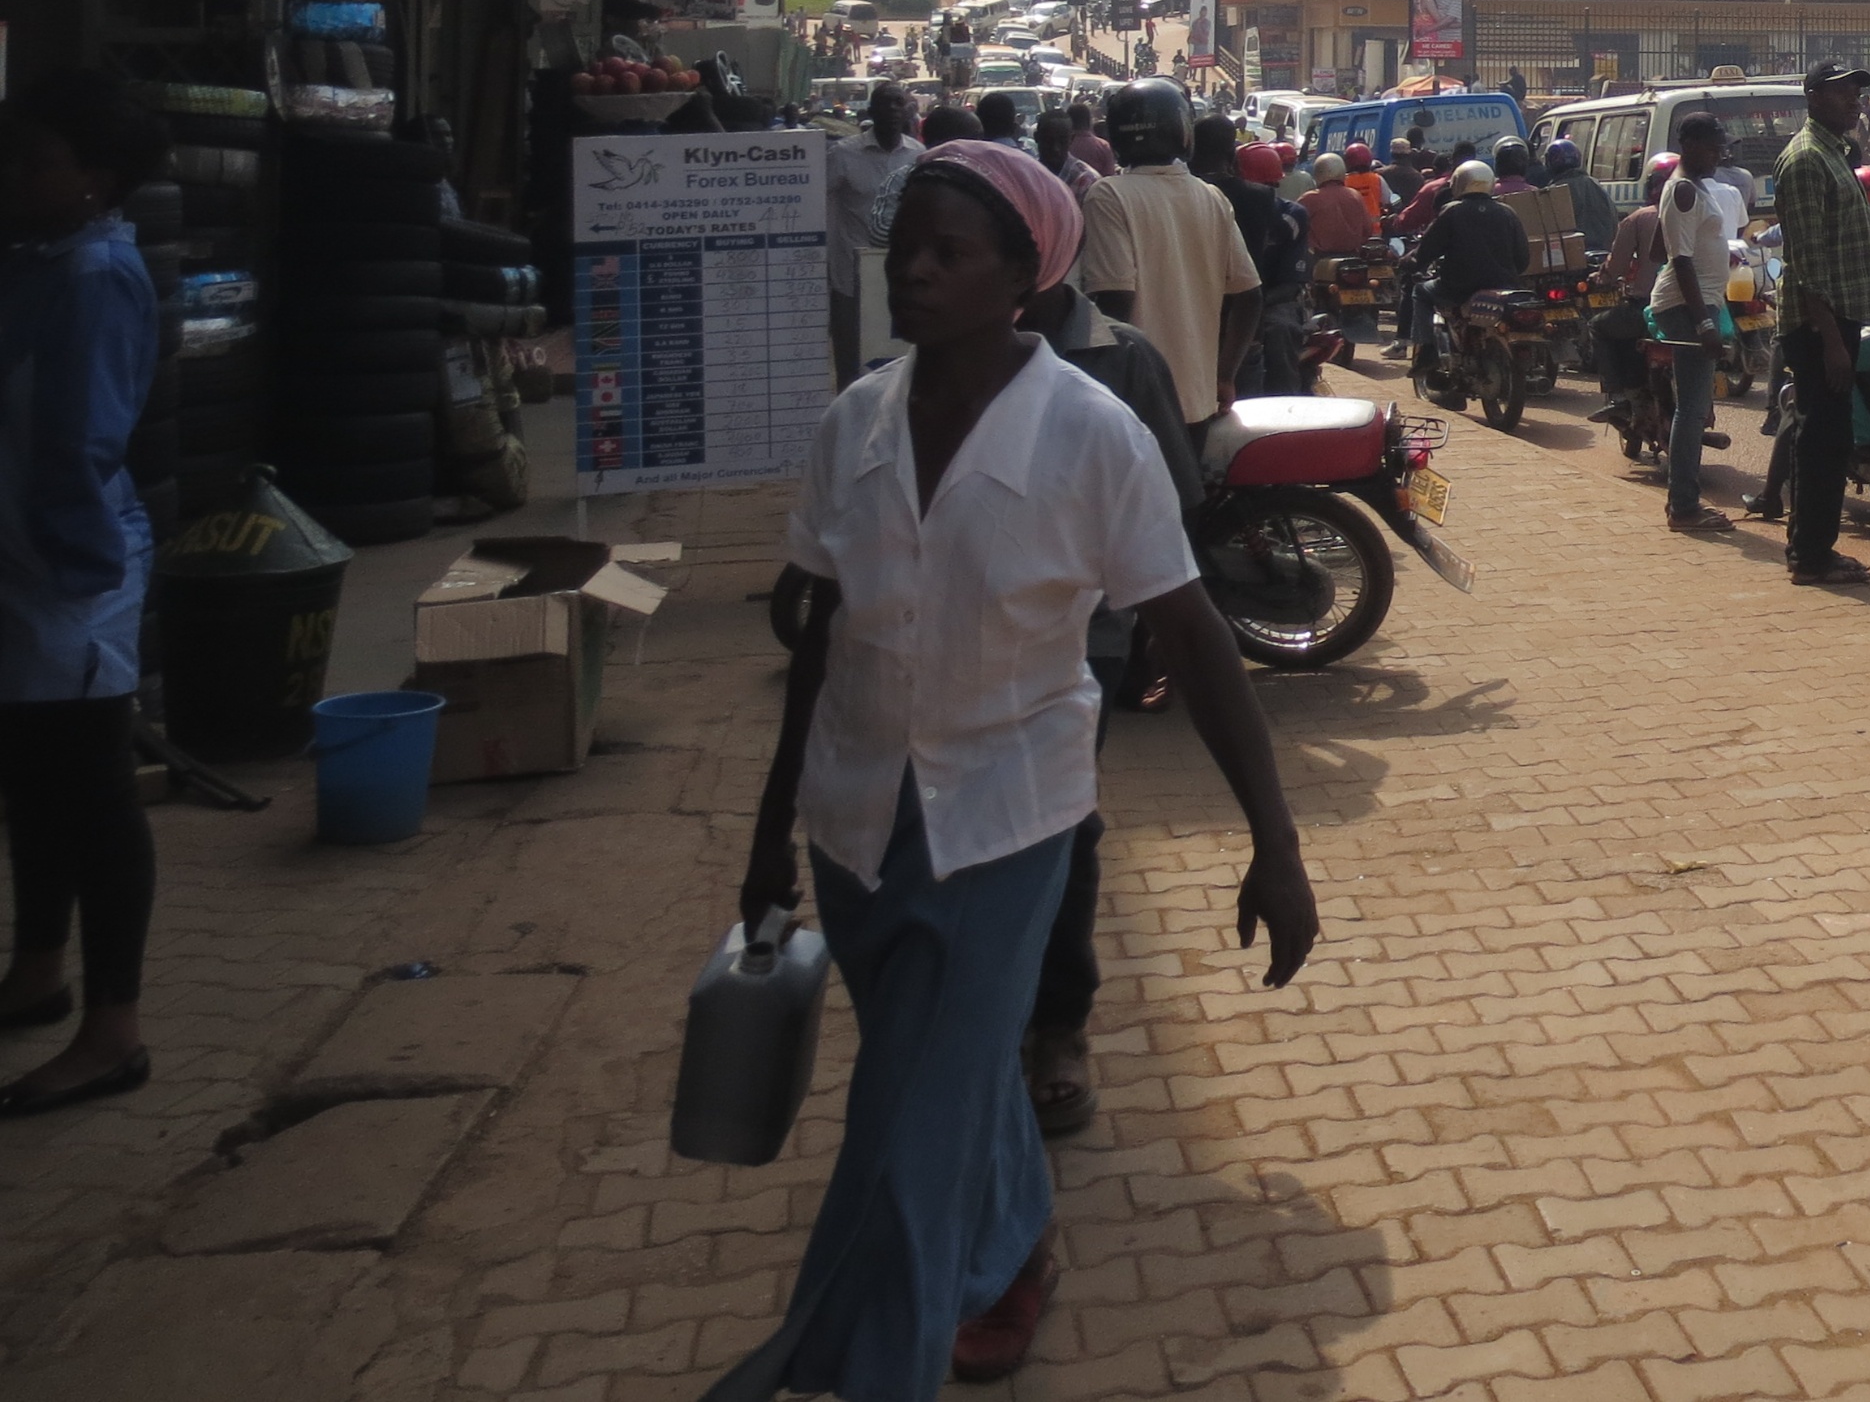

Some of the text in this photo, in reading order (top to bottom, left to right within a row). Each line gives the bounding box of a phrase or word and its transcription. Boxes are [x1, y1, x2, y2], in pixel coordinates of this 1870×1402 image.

[1399, 106, 1502, 126] HMELAND
[684, 145, 806, 166] Klyn-Cash
[687, 172, 810, 188] Forex Bureau
[598, 202, 622, 211] Tel:
[662, 209, 740, 221] OPEN DAILY
[645, 222, 756, 236] TODAY'S RATES
[642, 236, 818, 250] CURRENCY BUYING SELLING
[635, 465, 781, 484] And all Major Currencies
